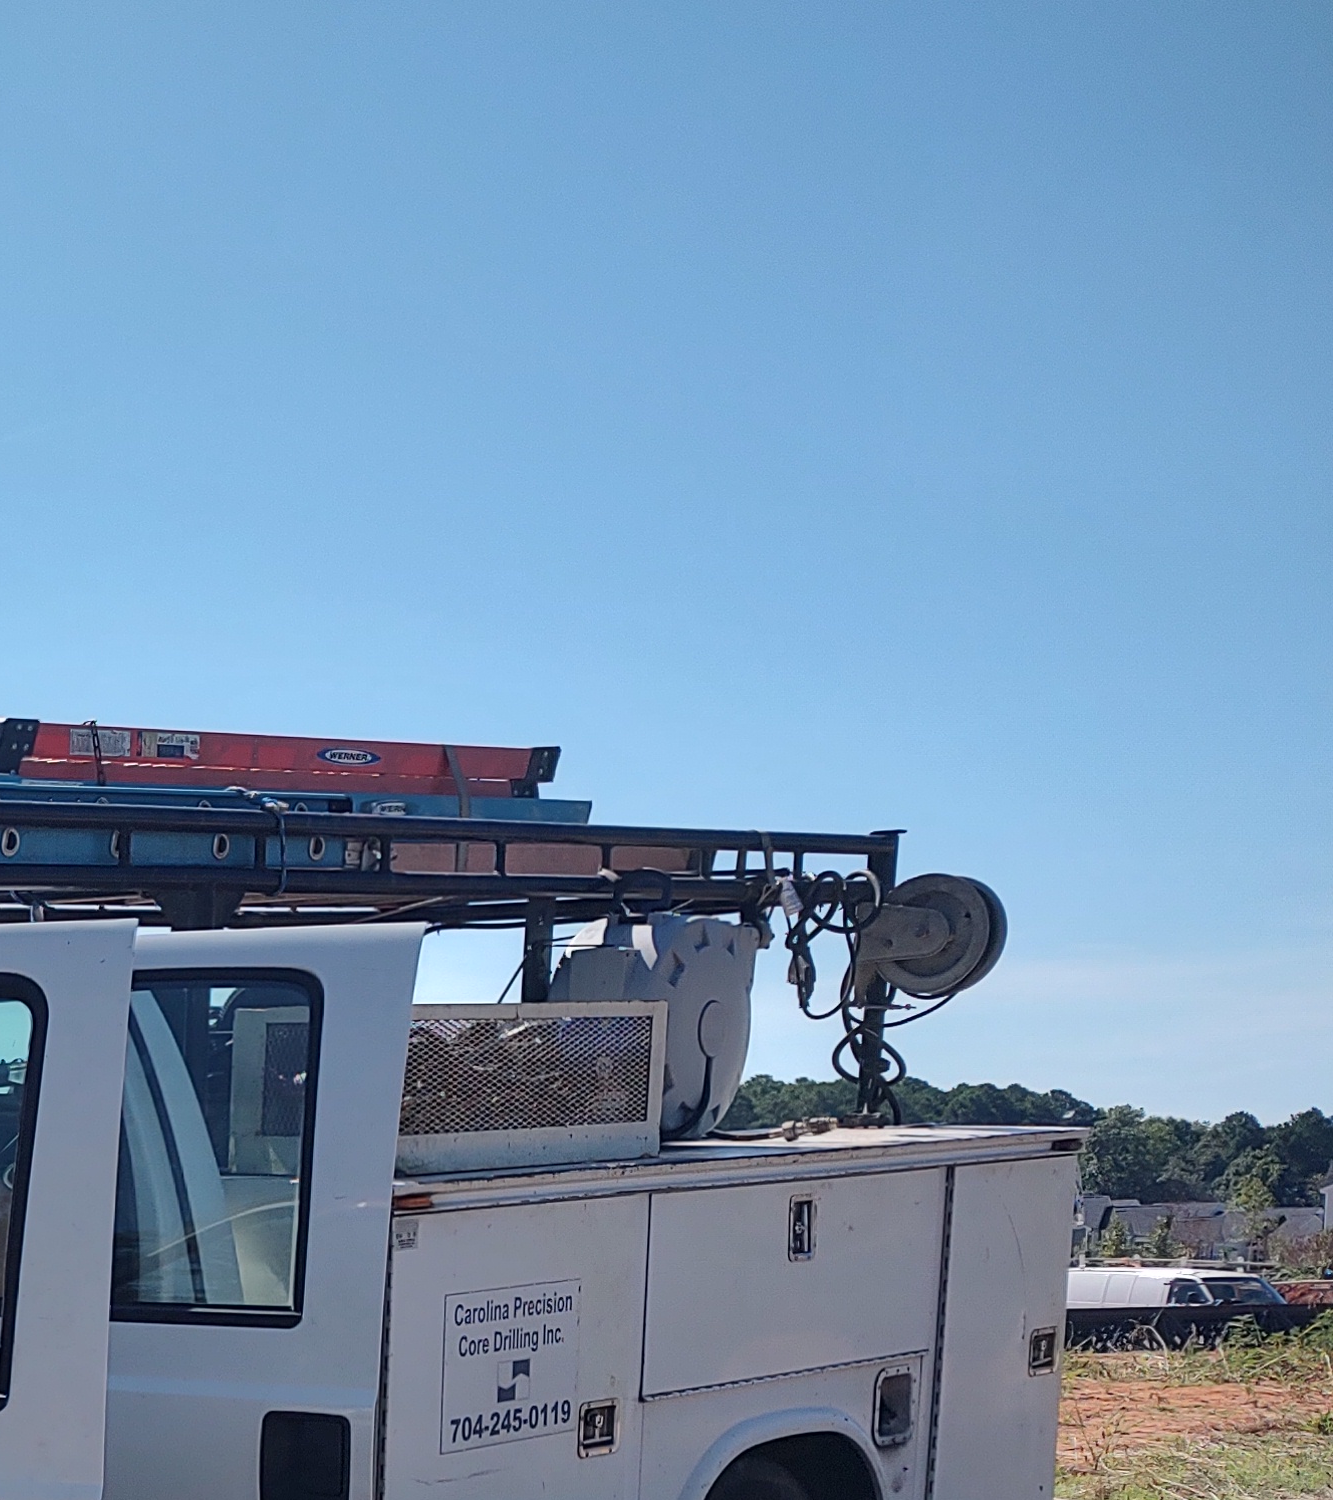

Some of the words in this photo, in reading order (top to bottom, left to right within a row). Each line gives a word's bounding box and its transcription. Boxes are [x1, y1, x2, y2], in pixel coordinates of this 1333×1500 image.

[330, 751, 368, 761] WERNER
[454, 1300, 510, 1327] Carolina
[513, 1292, 573, 1319] Precision
[458, 1335, 490, 1357] Core
[493, 1327, 539, 1352] Drilling
[542, 1324, 565, 1346] Inc.
[450, 1399, 572, 1444] 704-245-0119
